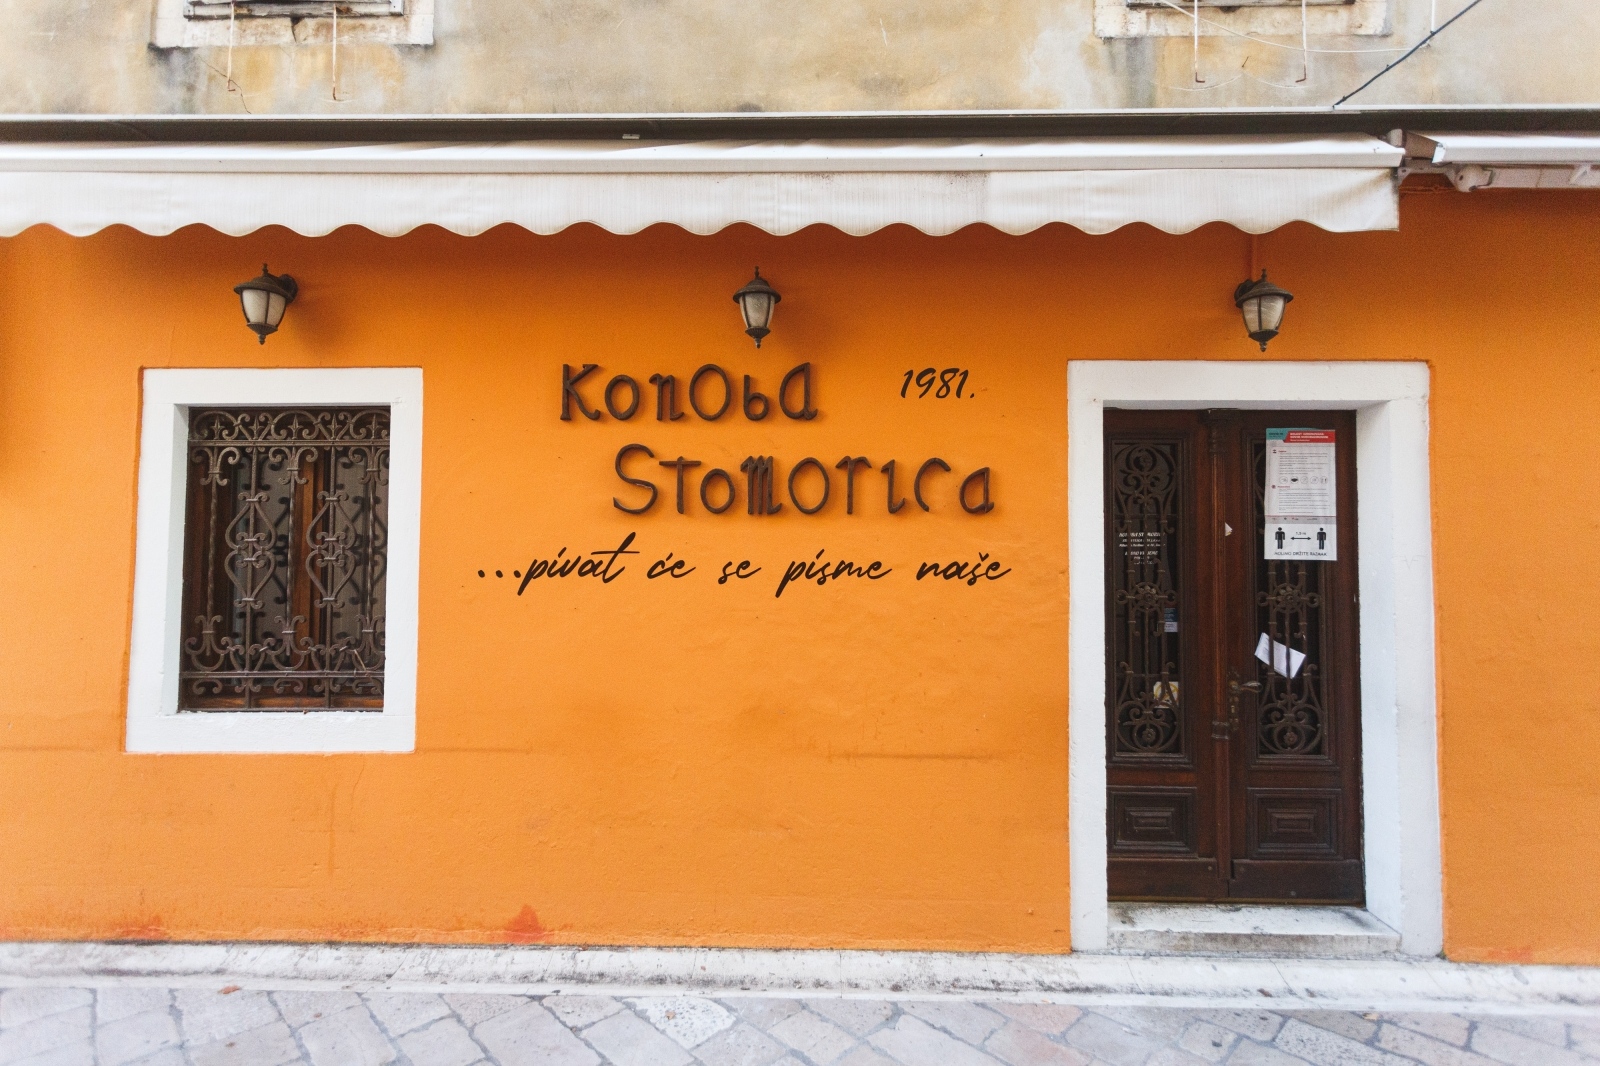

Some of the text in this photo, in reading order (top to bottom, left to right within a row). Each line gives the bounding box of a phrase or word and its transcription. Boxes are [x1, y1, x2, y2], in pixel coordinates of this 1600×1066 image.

[900, 367, 975, 399] 1981.
[646, 552, 696, 580] će
[717, 560, 762, 585] se
[775, 548, 893, 599] pisme
[916, 552, 1012, 587] naše
